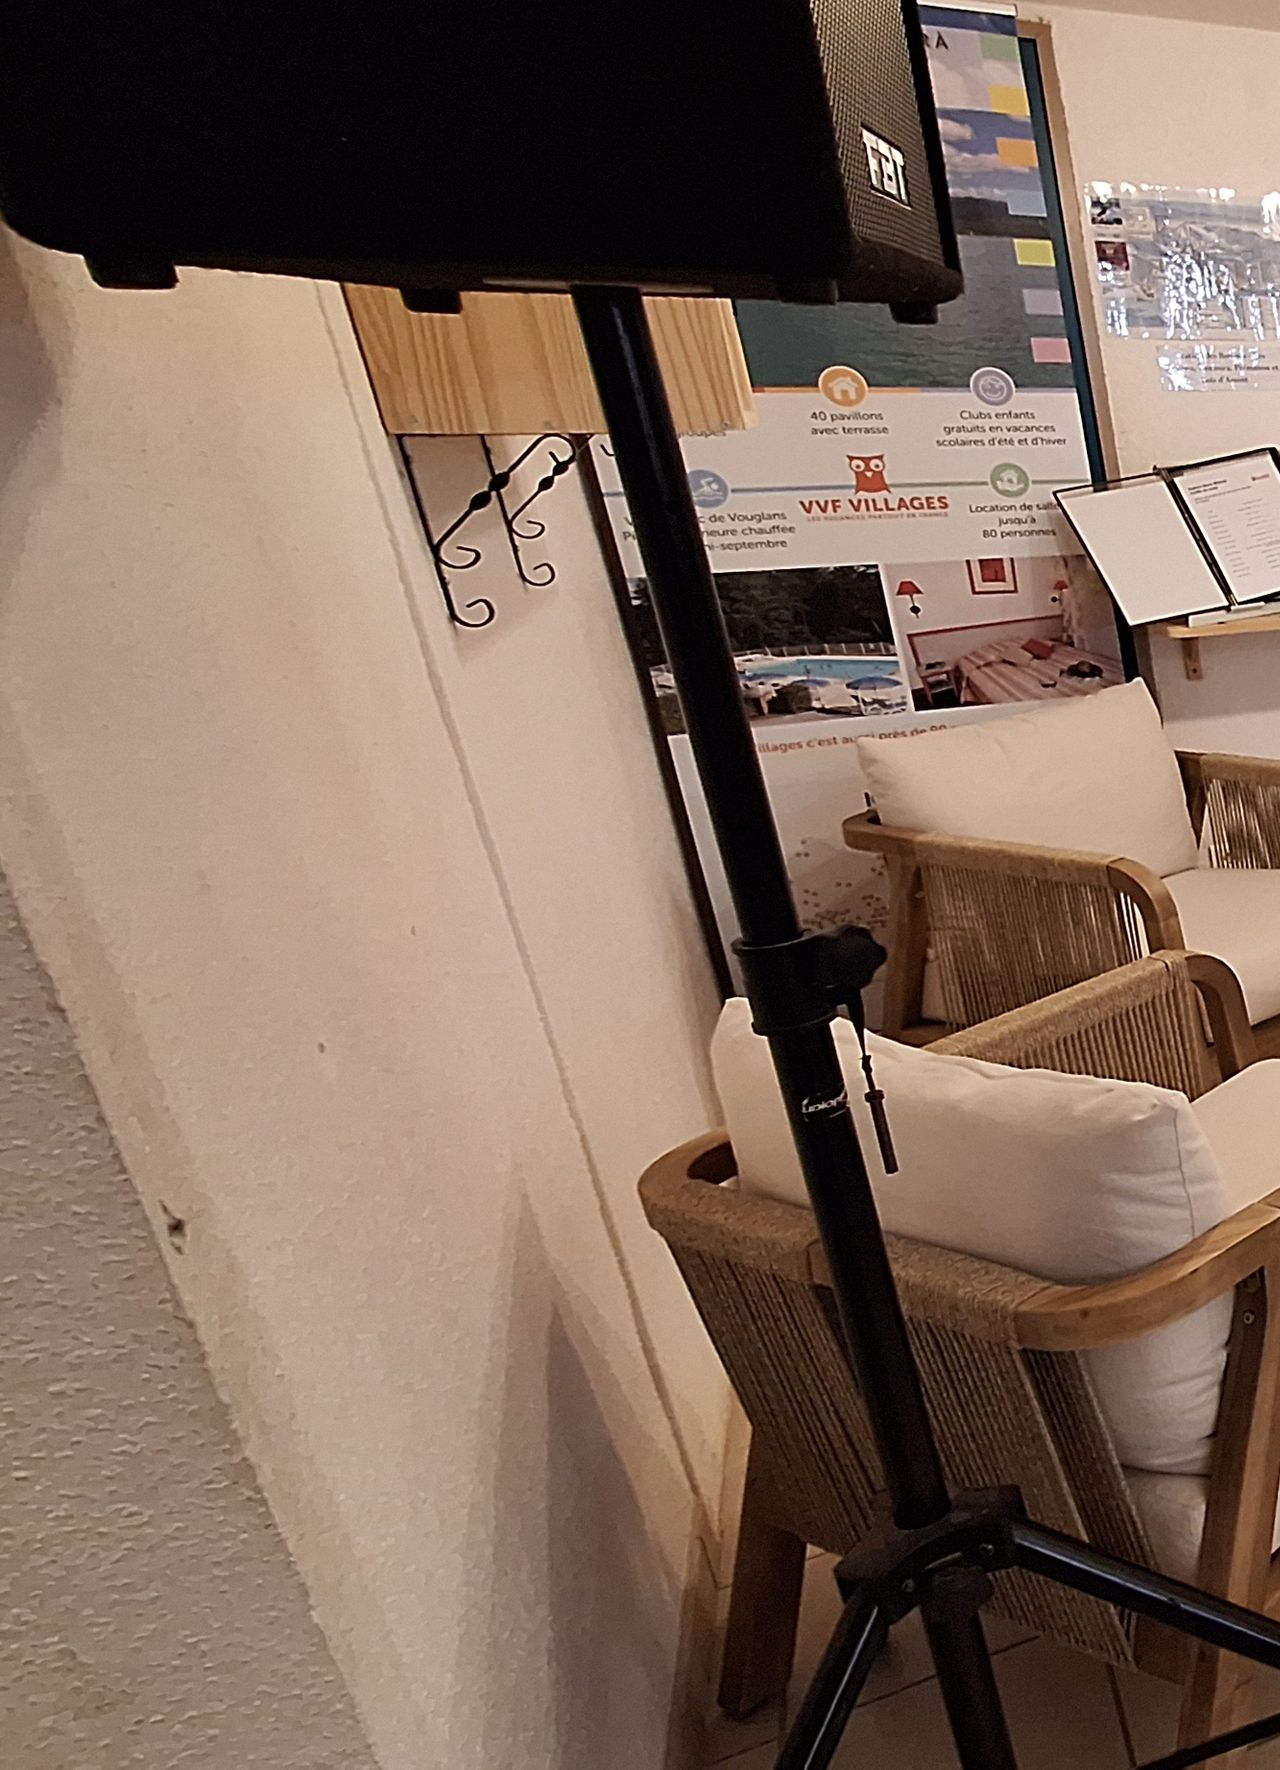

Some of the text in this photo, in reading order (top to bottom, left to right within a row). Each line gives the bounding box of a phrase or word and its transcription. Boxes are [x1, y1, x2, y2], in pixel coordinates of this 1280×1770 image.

[810, 410, 884, 423] 40 pavillons
[959, 409, 1036, 420] Clubs enfants
[811, 425, 889, 436] avec terrasse
[943, 424, 1056, 436] gratuits en vacances
[935, 436, 1067, 447] scolaires d'été et d'hiver
[798, 495, 950, 515] VVF VILLAGES
[968, 503, 1017, 514] Location
[1020, 502, 1034, 512] de
[708, 513, 726, 524] de
[727, 511, 788, 525] Vouglans
[982, 528, 1057, 540] 80 personnes
[757, 741, 803, 754] illages
[806, 736, 838, 748] c'est
